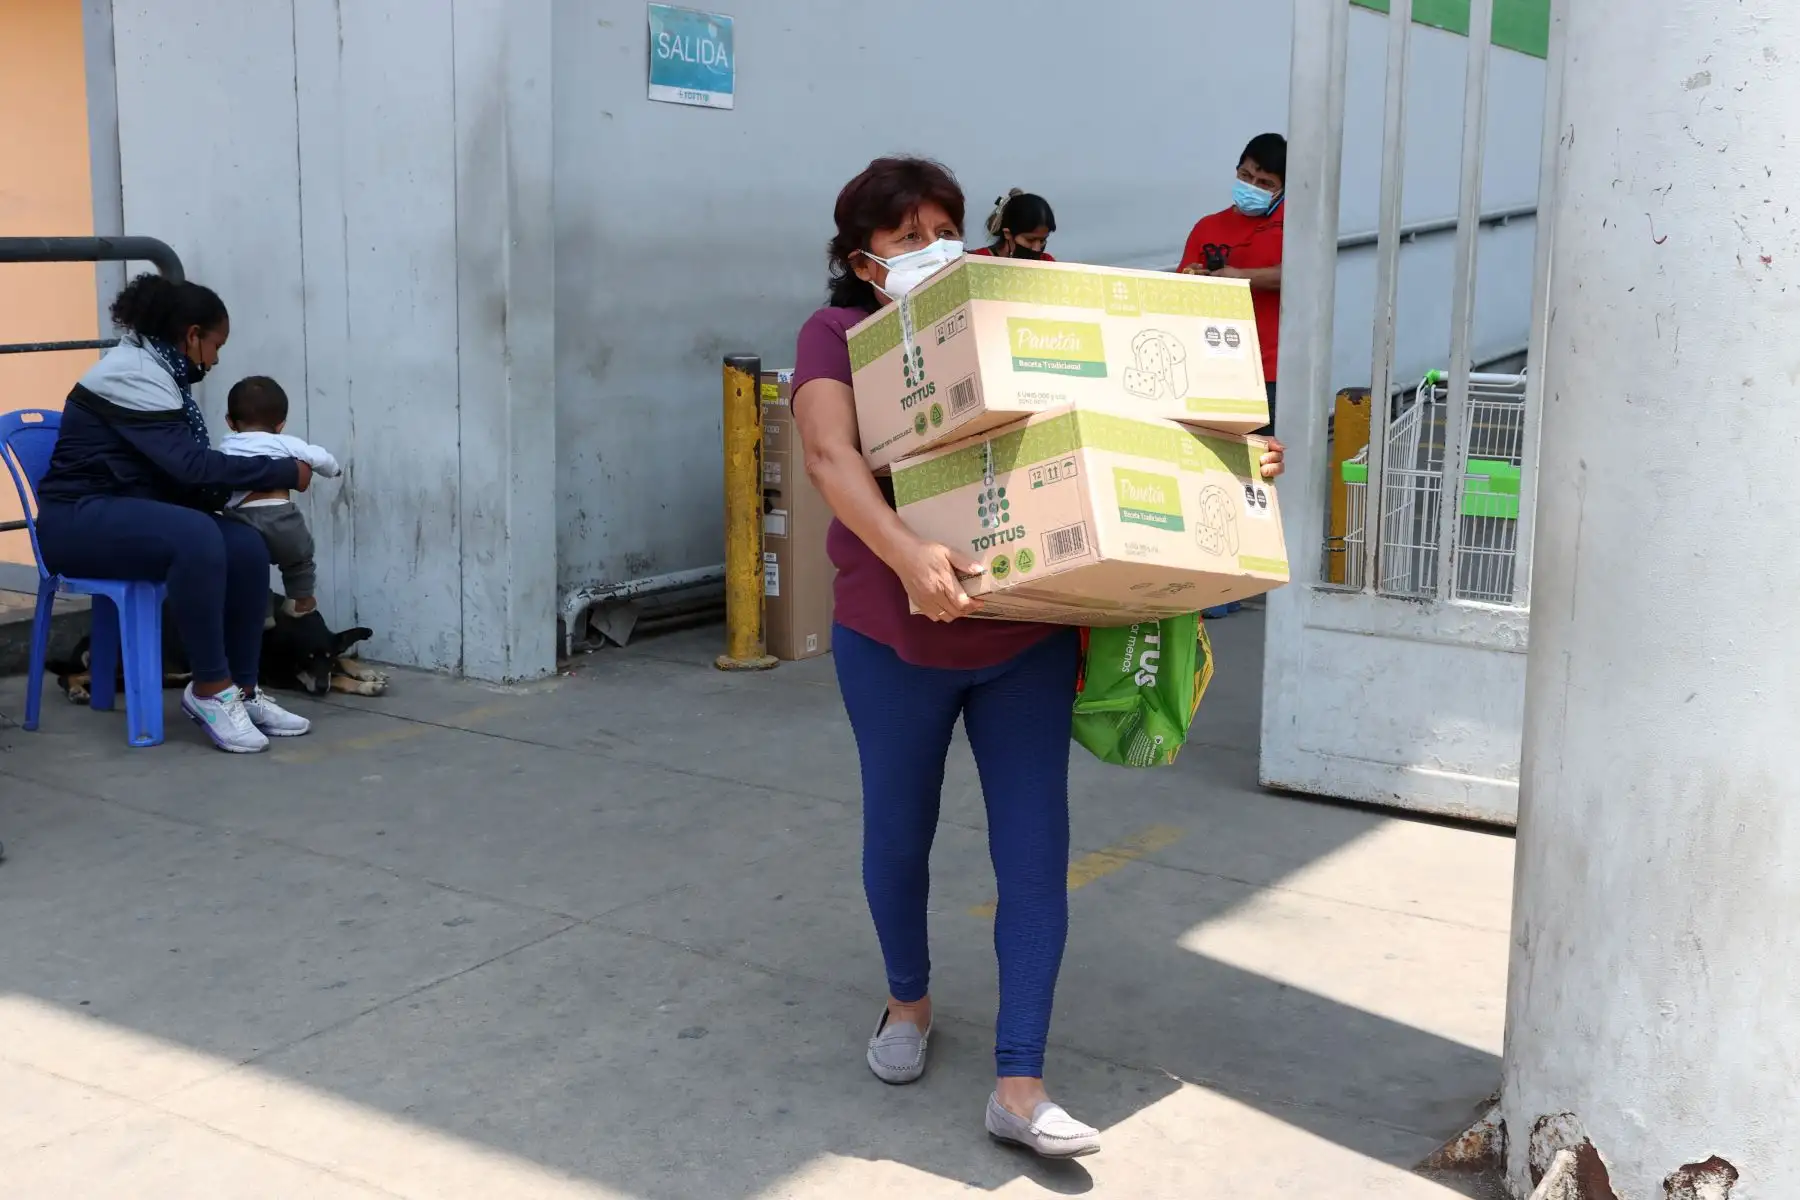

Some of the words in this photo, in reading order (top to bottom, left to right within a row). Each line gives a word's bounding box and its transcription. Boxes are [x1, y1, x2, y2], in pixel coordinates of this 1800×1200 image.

[657, 32, 729, 68] SALIDA
[1017, 327, 1080, 351] Panetón
[900, 381, 936, 411] TOTTUS
[1032, 470, 1042, 480] 12
[1120, 478, 1165, 505] Panetón
[971, 525, 1026, 552] TOTTUS
[1130, 624, 1140, 635] or
[1122, 635, 1137, 673] menos
